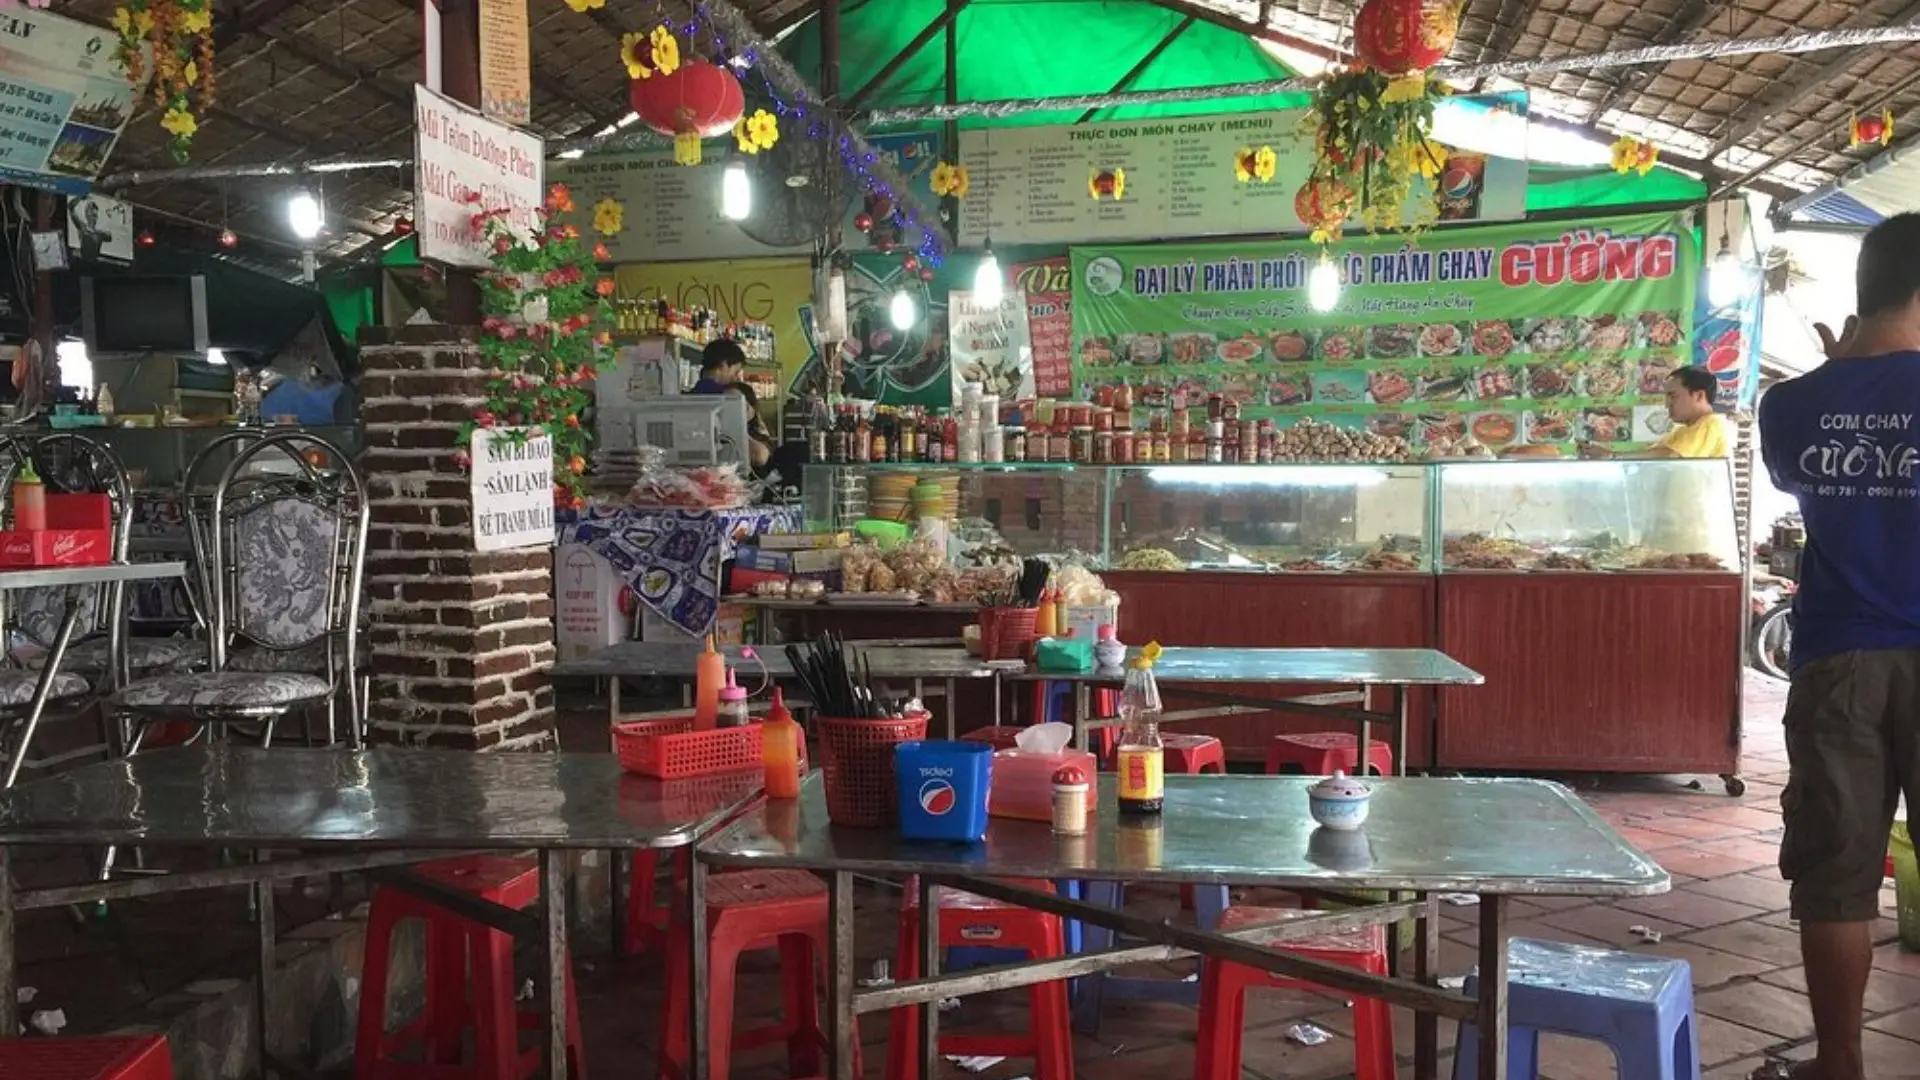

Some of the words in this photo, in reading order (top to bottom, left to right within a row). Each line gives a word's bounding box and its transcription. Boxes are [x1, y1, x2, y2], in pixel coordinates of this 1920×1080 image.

[1068, 128, 1106, 142] THỰC
[1109, 125, 1139, 140] ĐƠN
[1142, 122, 1174, 137] MÓN
[1178, 121, 1217, 134] CHAY
[1221, 118, 1273, 132] (MENU)
[1134, 266, 1168, 301] ĐẠI
[1173, 259, 1196, 294] LÝ
[1203, 256, 1255, 292] PHÂN
[1260, 251, 1305, 290] PHỐI
[1369, 243, 1431, 288] PHẨM
[1437, 247, 1494, 283] CHAY
[1499, 228, 1680, 289] CƯỜNG
[1865, 413, 1912, 430] CHAY
[1799, 433, 1920, 479] CƯỜNG
